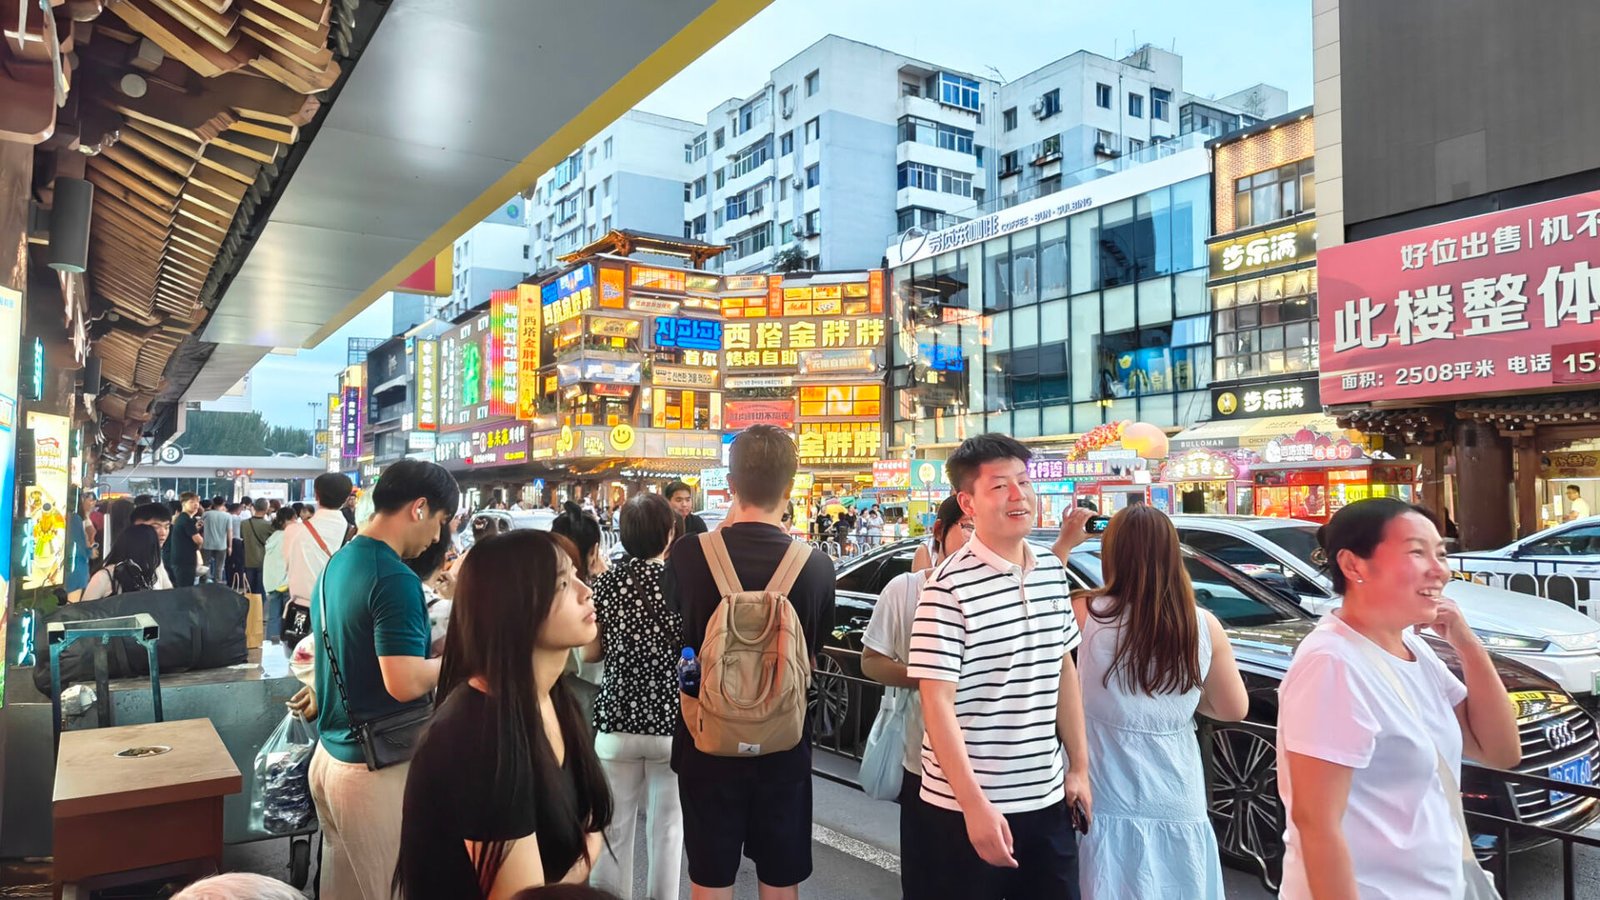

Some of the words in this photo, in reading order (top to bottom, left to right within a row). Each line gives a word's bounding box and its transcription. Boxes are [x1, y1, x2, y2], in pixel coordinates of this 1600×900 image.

[1000, 216, 1029, 232] COFFEE
[1034, 208, 1052, 222] BUN
[1056, 197, 1093, 216] SULBING
[1222, 230, 1297, 272] 步乐满
[1400, 224, 1521, 271] 好位出售
[1333, 260, 1600, 353] 此楼整体
[460, 323, 471, 340] KTV
[477, 315, 489, 332] KTV
[655, 316, 722, 351] 진파파
[723, 318, 885, 350] 西塔金胖胖
[522, 315, 537, 372] 西塔金胖胖
[683, 350, 717, 366] 首尔
[725, 350, 798, 367] 烤肉自助
[1395, 358, 1495, 386] 2508平米
[1507, 352, 1552, 375] 电话
[1562, 351, 1600, 374] 15
[476, 405, 488, 420] KTV
[1242, 387, 1305, 413] 步乐满
[459, 410, 470, 424] KTV
[798, 430, 881, 458] 金胖胖
[1180, 439, 1225, 449] BULLOMAN
